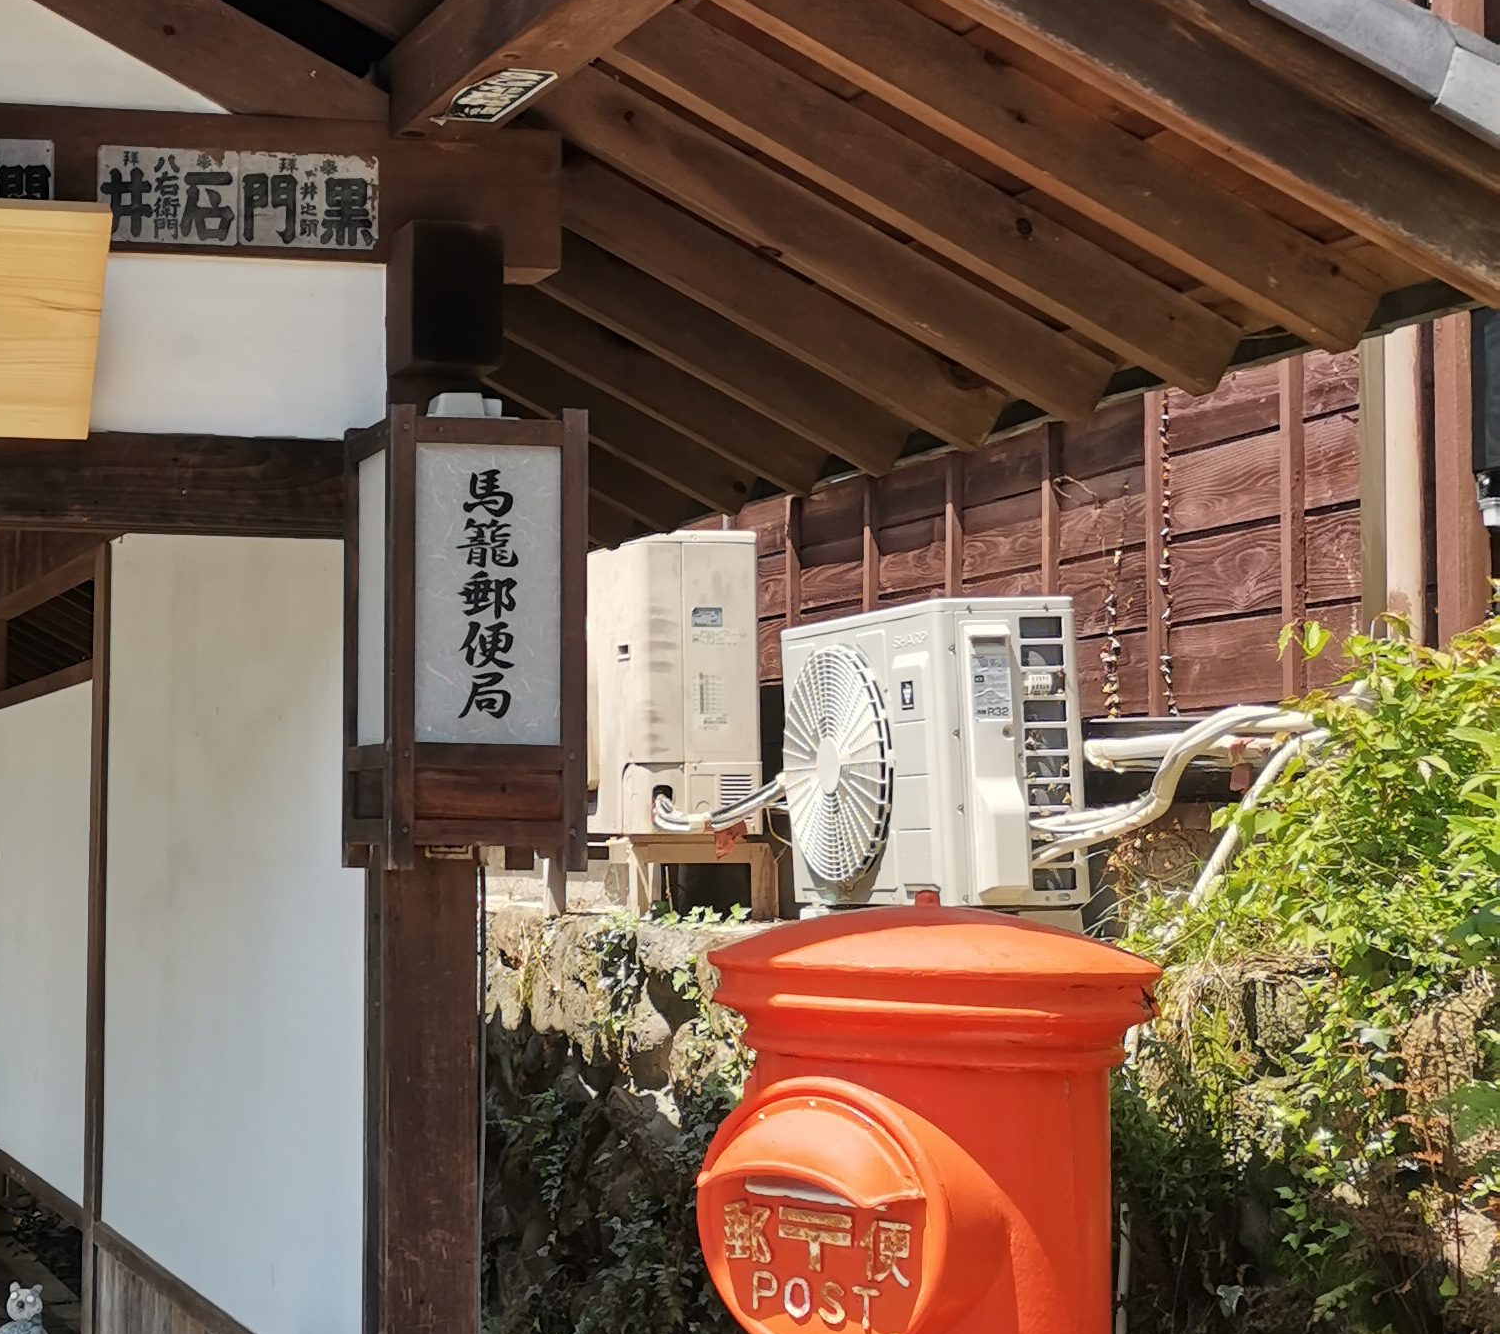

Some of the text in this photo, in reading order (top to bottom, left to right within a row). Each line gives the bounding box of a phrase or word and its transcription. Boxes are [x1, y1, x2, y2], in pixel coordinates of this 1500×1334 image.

[455, 469, 519, 719] 馬籠郵便局
[752, 1269, 881, 1331] POST
